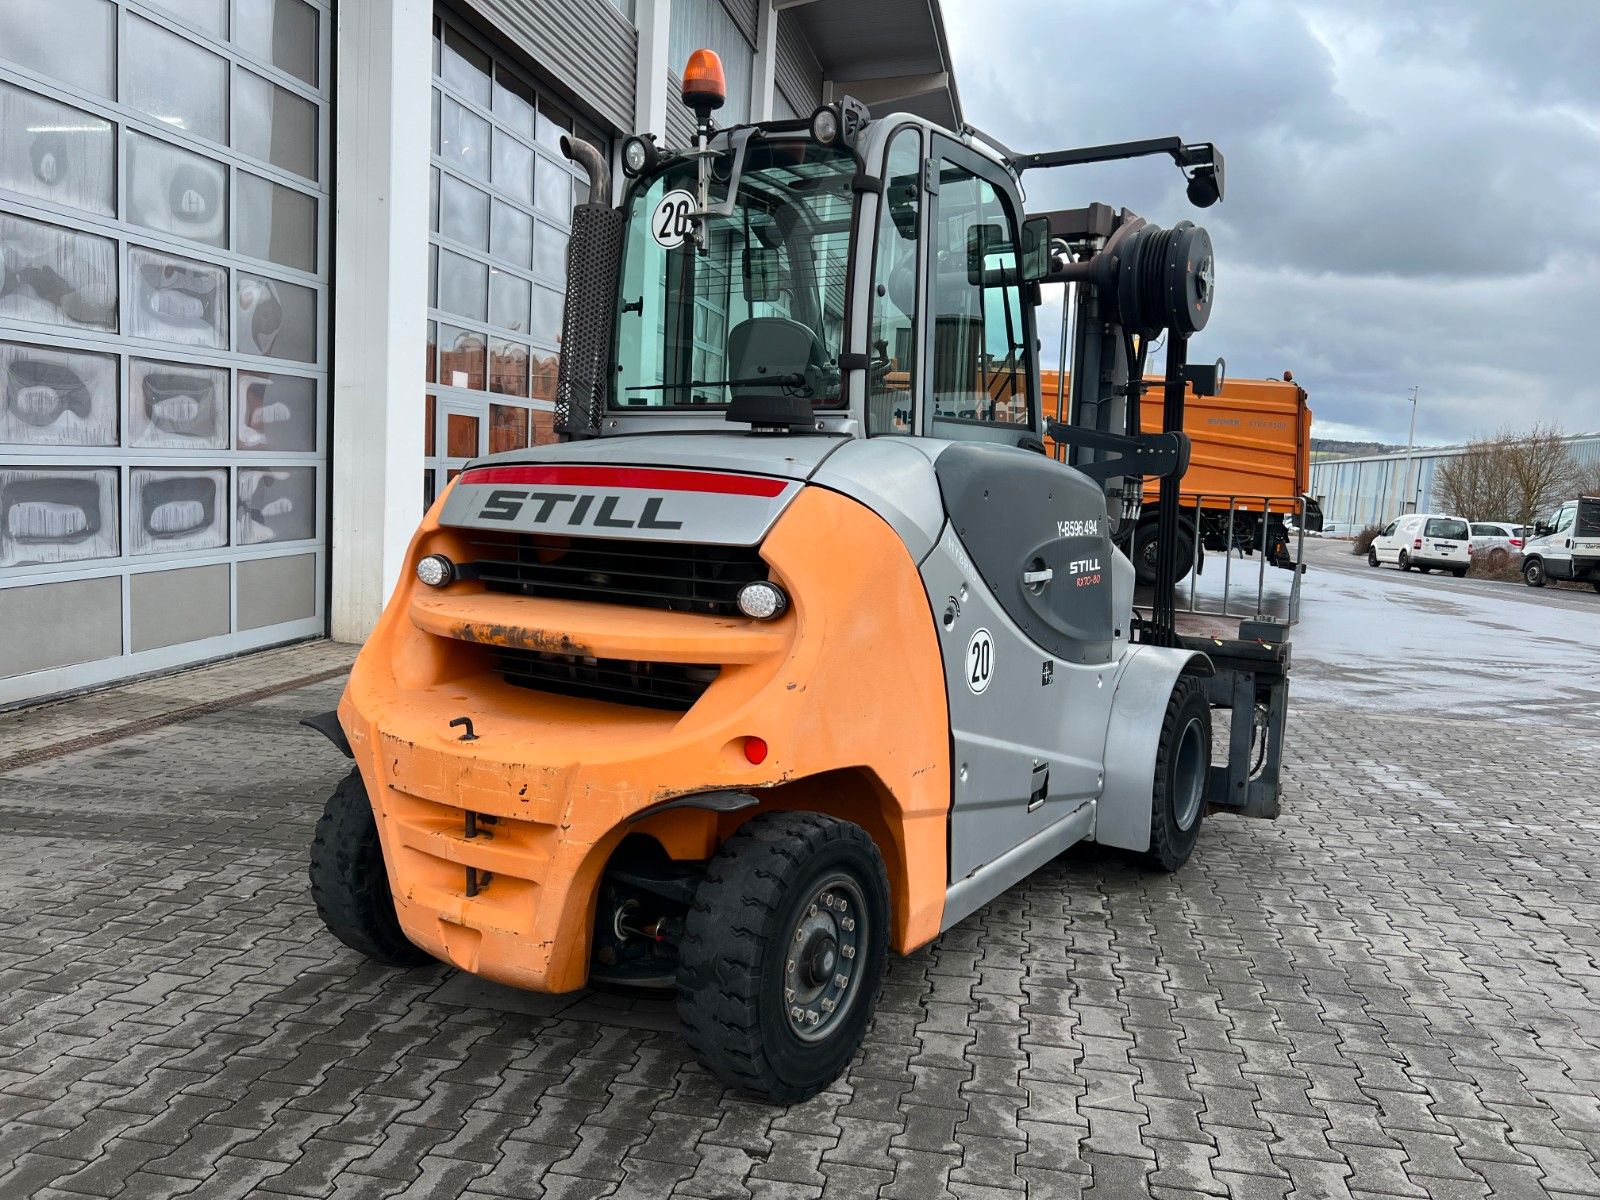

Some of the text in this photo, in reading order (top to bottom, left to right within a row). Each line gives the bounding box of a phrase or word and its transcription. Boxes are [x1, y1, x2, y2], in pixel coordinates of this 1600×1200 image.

[658, 200, 690, 238] 20
[478, 489, 684, 531] STILL
[1069, 558, 1101, 575] STILL
[971, 639, 990, 684] 20
